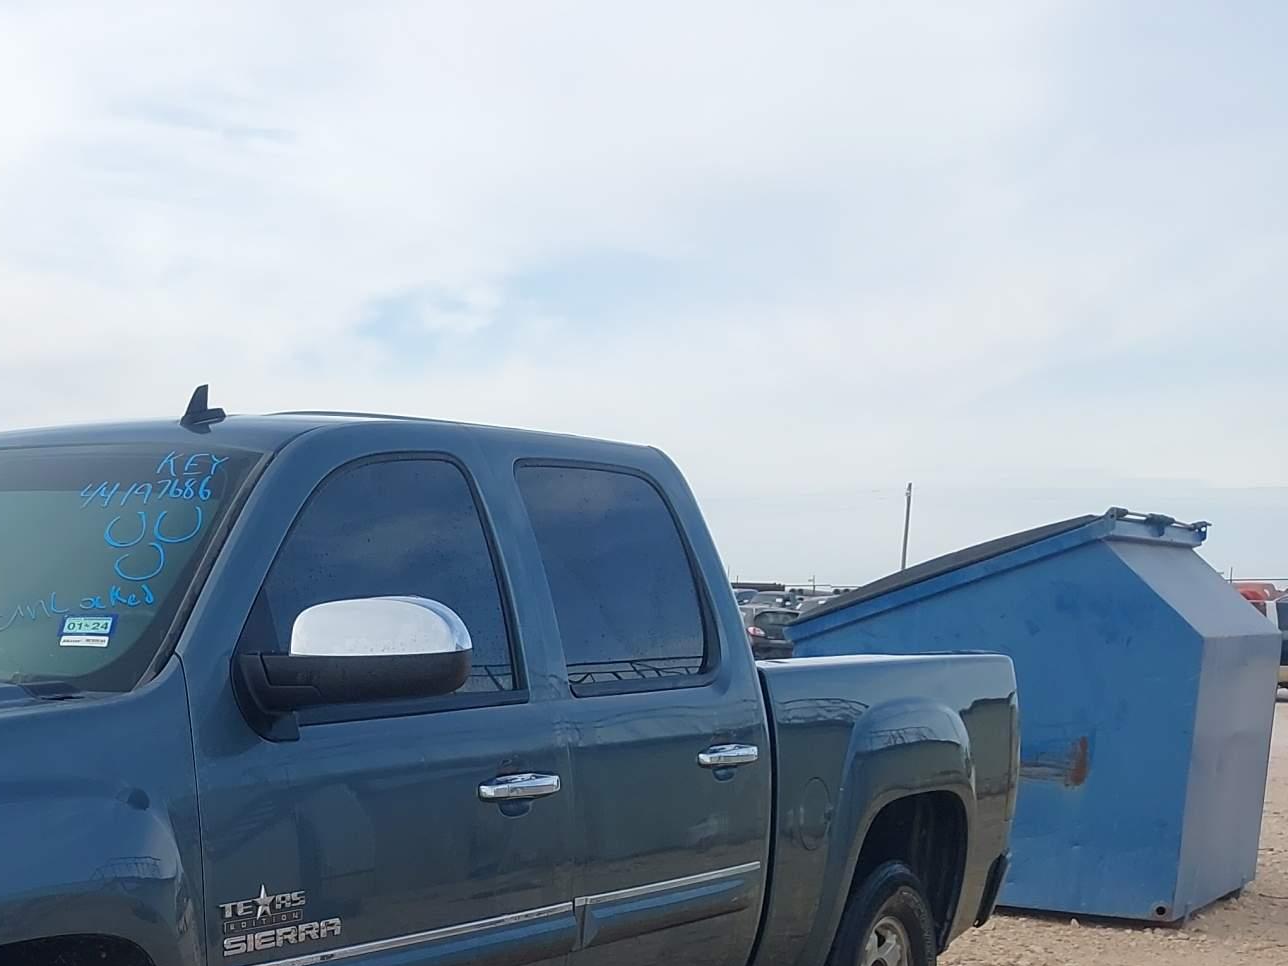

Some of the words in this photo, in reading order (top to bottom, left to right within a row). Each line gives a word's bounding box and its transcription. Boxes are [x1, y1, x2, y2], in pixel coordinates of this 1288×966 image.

[156, 451, 229, 477] KEY
[80, 476, 212, 508] 44197686
[219, 884, 306, 920] TEXAS
[223, 917, 342, 957] SIERRA
[229, 911, 301, 931] EDITION
